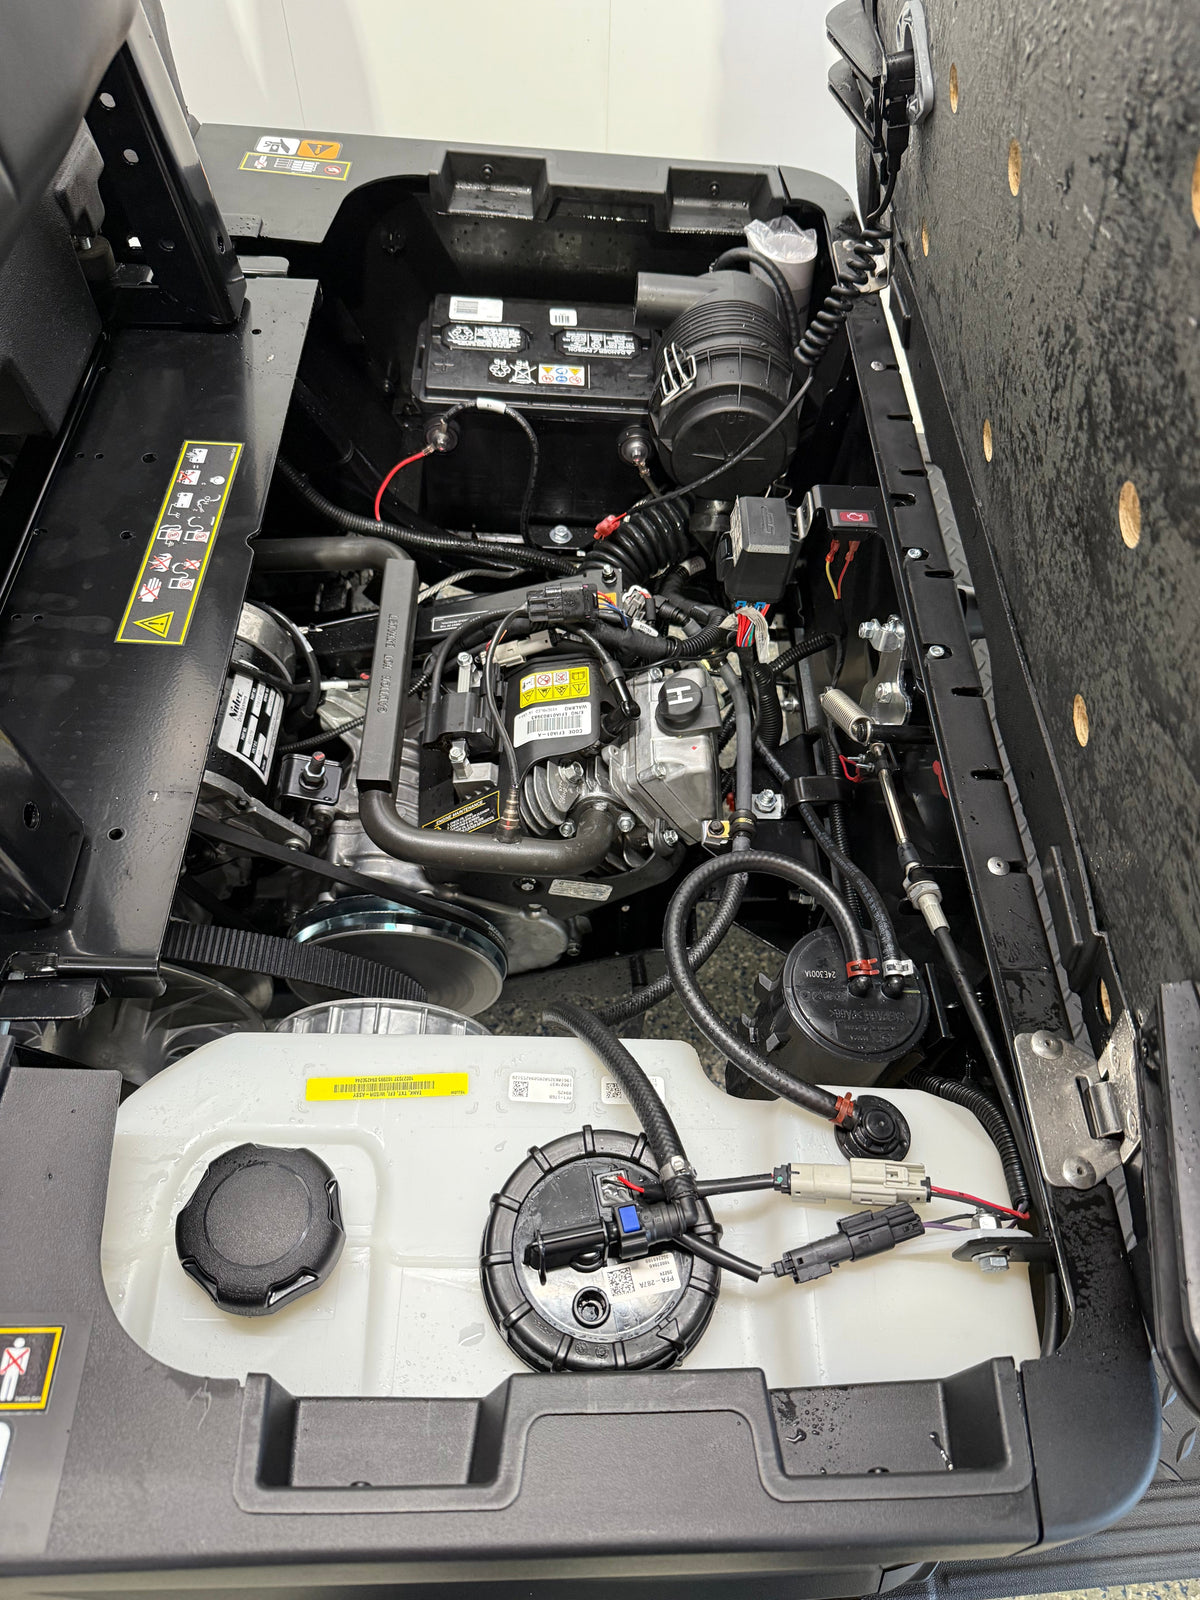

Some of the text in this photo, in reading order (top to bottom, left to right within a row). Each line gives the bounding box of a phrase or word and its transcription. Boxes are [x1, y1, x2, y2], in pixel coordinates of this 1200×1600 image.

[228, 688, 244, 720] Nidec
[665, 685, 694, 705] H
[805, 970, 836, 978] 24E3001A
